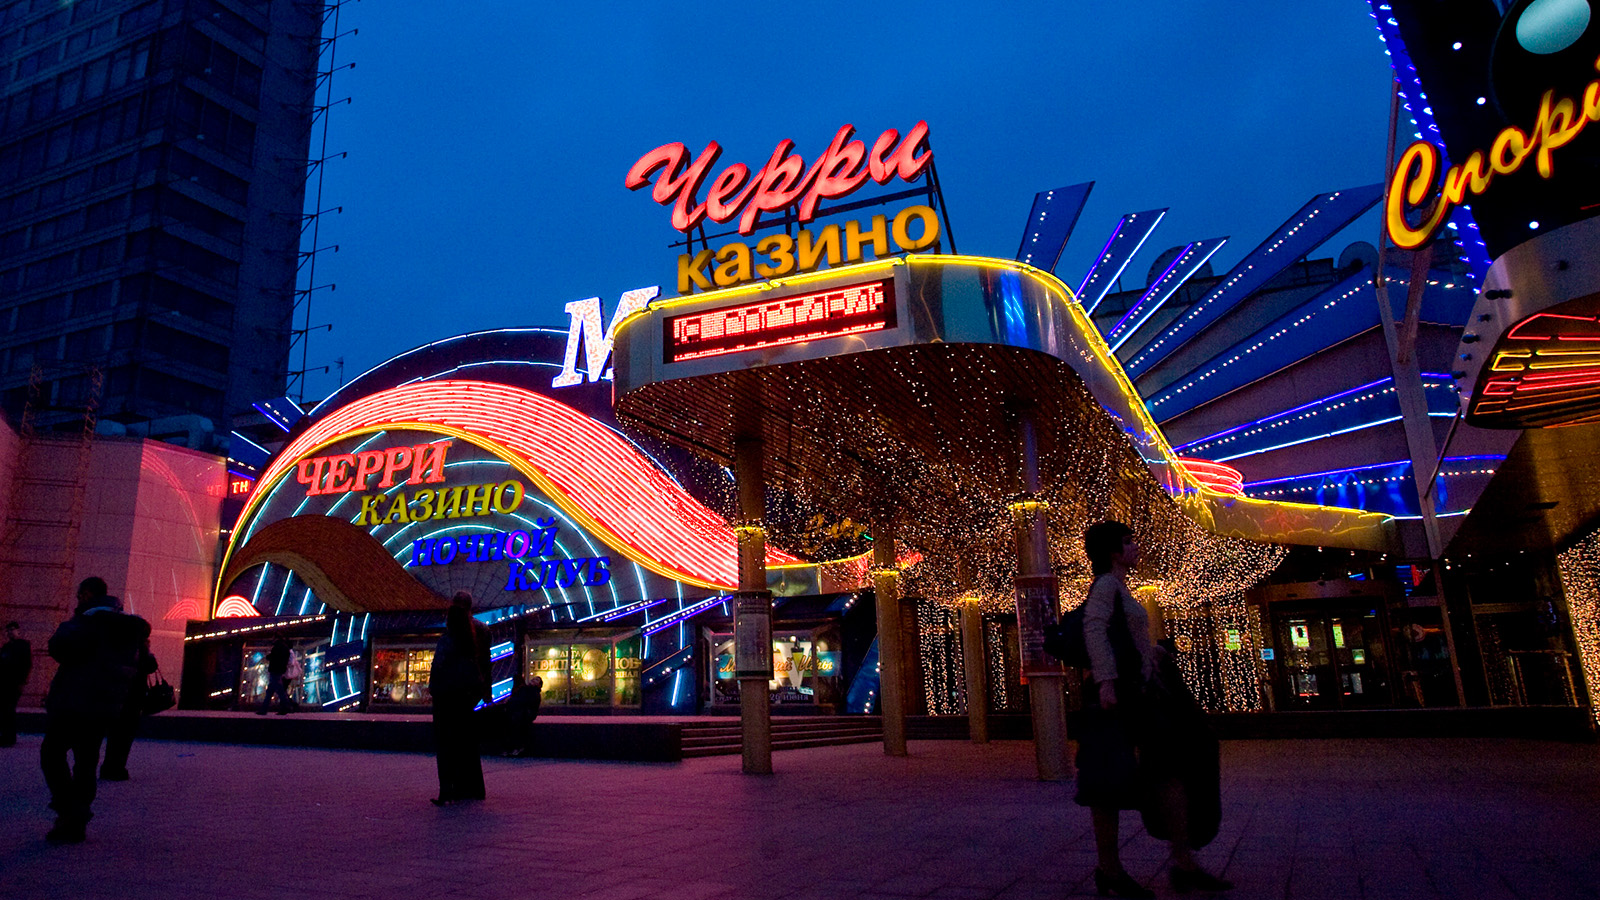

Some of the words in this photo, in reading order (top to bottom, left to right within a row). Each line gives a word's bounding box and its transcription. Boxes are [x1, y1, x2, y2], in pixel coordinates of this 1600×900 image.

[625, 119, 934, 236] Черри
[297, 440, 453, 496] ЧЕРРИ
[355, 479, 526, 526] КАЗИНО
[409, 516, 558, 567] НОЧНОЙ
[504, 556, 613, 592] КЛУБ
